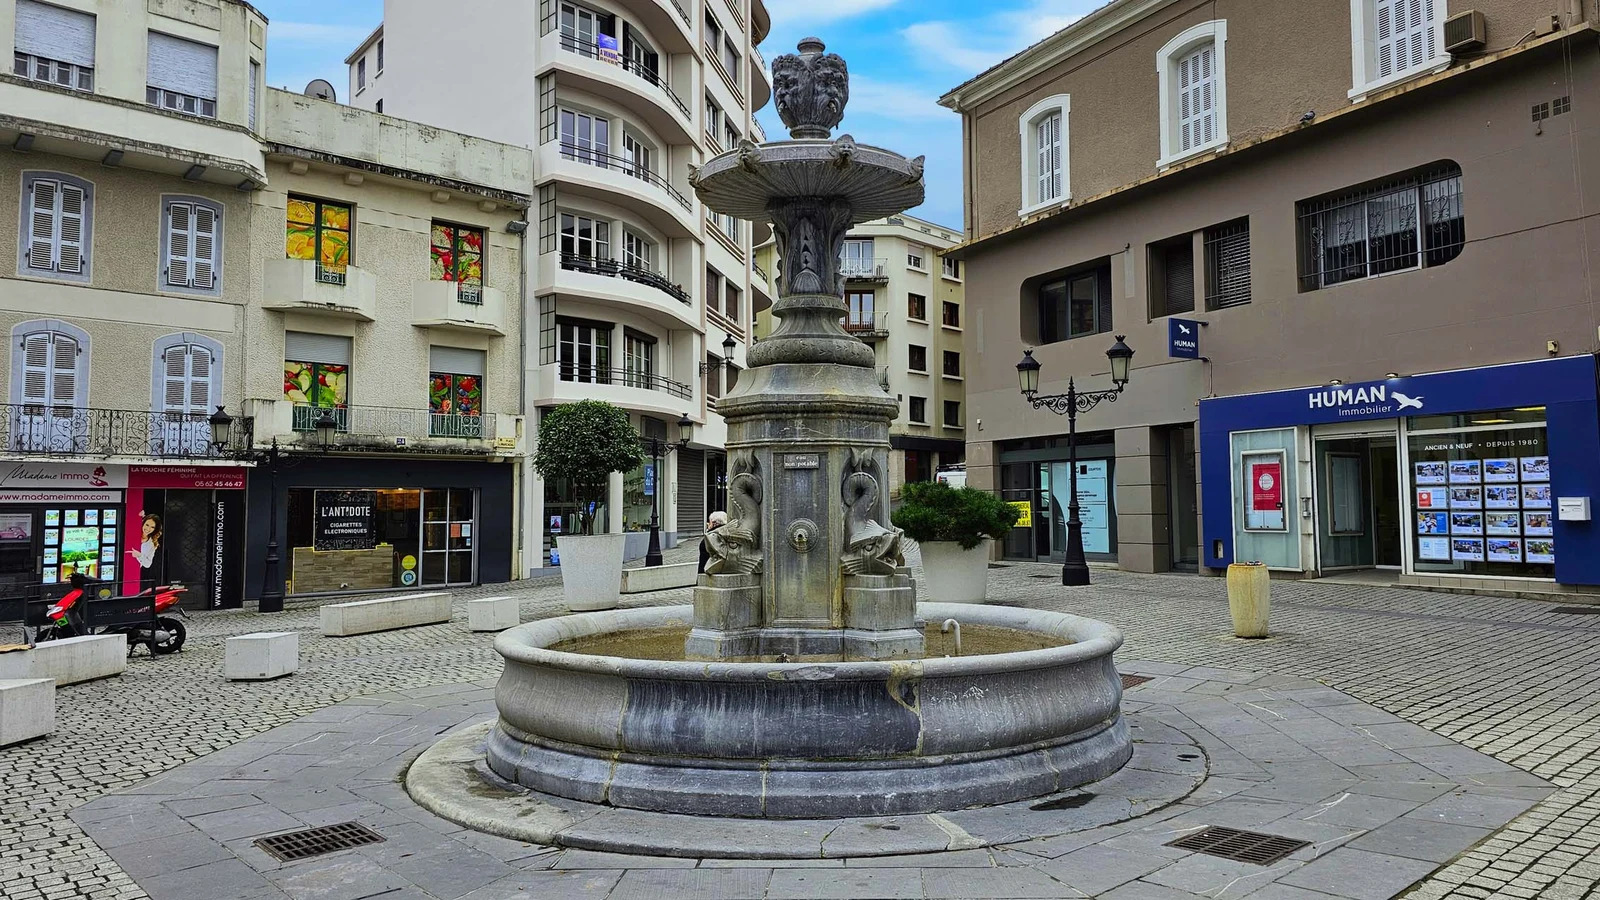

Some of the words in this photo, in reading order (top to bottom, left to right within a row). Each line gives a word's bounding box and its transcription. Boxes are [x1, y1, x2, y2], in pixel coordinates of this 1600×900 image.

[1174, 340, 1195, 348] HUMAN
[1309, 385, 1385, 408] HUMAN
[1339, 405, 1392, 416] Immobilier
[1486, 440, 1515, 448] DEPUIS
[1518, 438, 1539, 446] 1980
[0, 464, 57, 486] Madame
[60, 472, 90, 480] immo
[321, 506, 371, 517] L'ANTIDOTE
[214, 501, 225, 606] www.madameimmo.com
